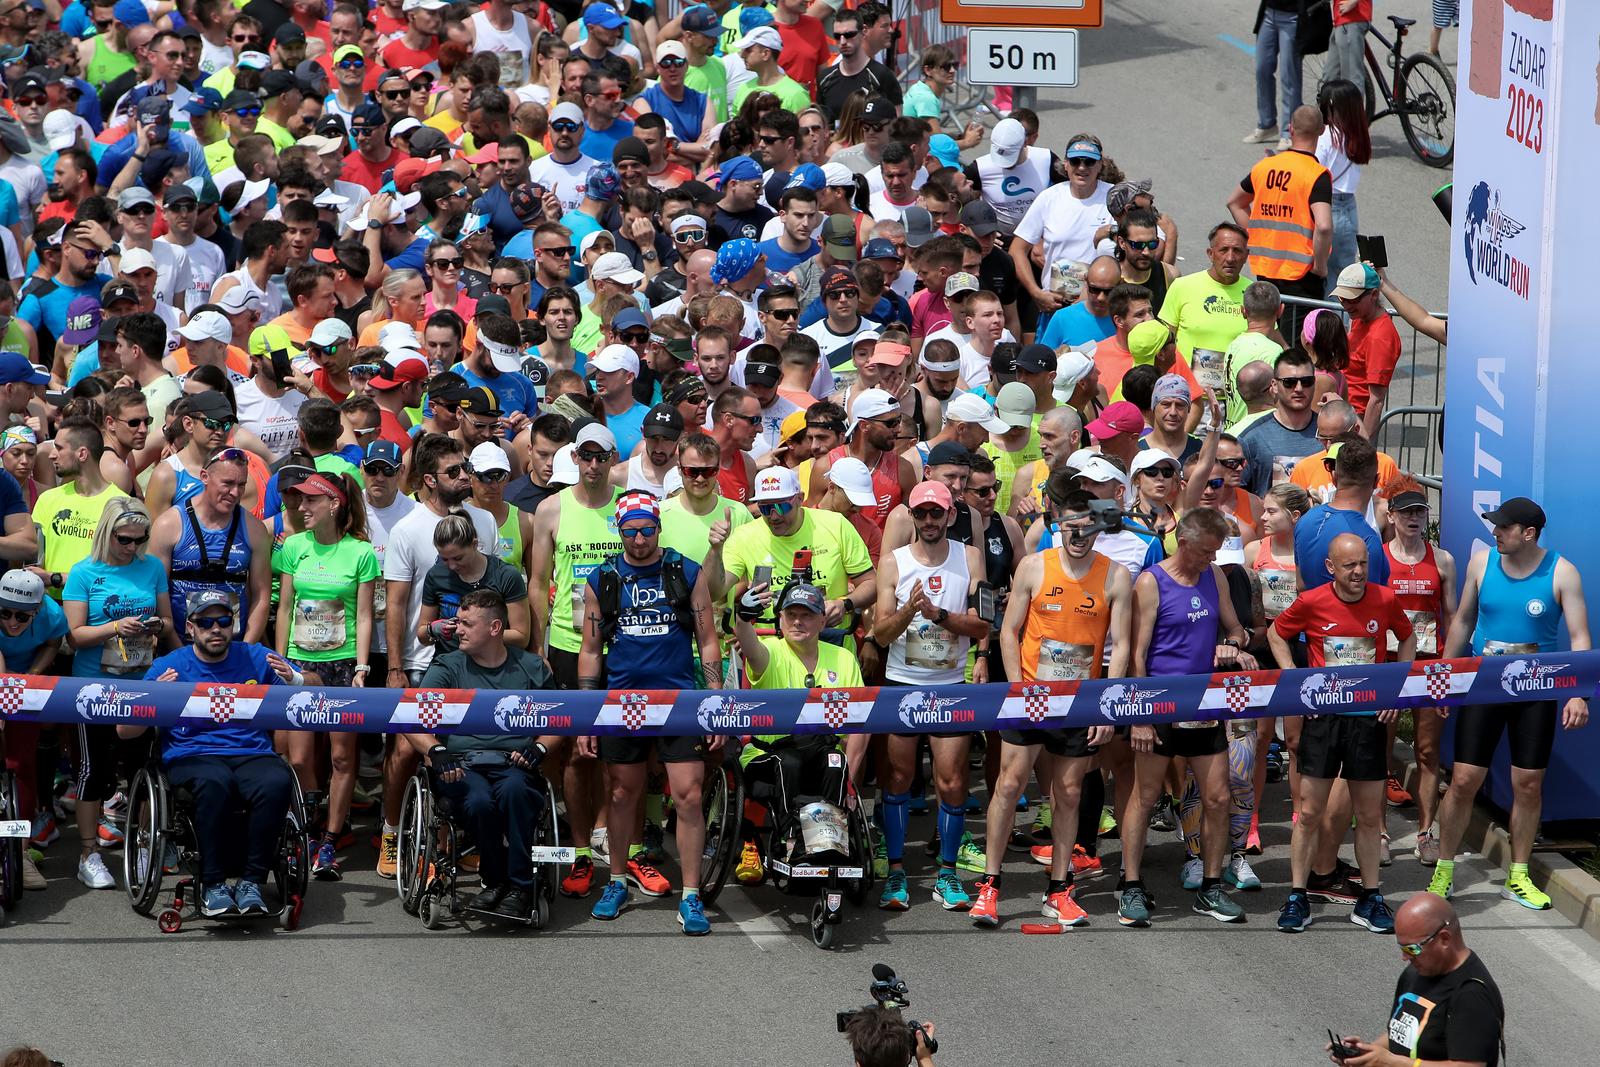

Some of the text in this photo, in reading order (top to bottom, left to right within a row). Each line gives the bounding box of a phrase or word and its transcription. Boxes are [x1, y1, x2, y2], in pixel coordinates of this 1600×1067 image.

[989, 44, 1056, 70] 50 m
[1509, 31, 1546, 90] ZADAR
[865, 102, 874, 112] S
[1506, 83, 1543, 154] 2023
[1266, 168, 1292, 192] 042
[1488, 209, 1512, 235] WINGS
[1476, 238, 1530, 300] WORLD RUN
[60, 524, 88, 538] WORLD
[656, 613, 676, 624] 100
[641, 626, 663, 634] UTMB
[1516, 676, 1577, 692] WORLD RUN
[100, 692, 131, 700] WINGS
[1315, 690, 1376, 705] WORLD RUN
[91, 704, 156, 718] WORLD RUN
[1114, 702, 1176, 716] WORLD RUN
[301, 711, 364, 724] WORLD RUN
[508, 715, 571, 728] WORLD RUN
[712, 714, 774, 728] WORLD RUN
[913, 710, 975, 724] WORLD RUN
